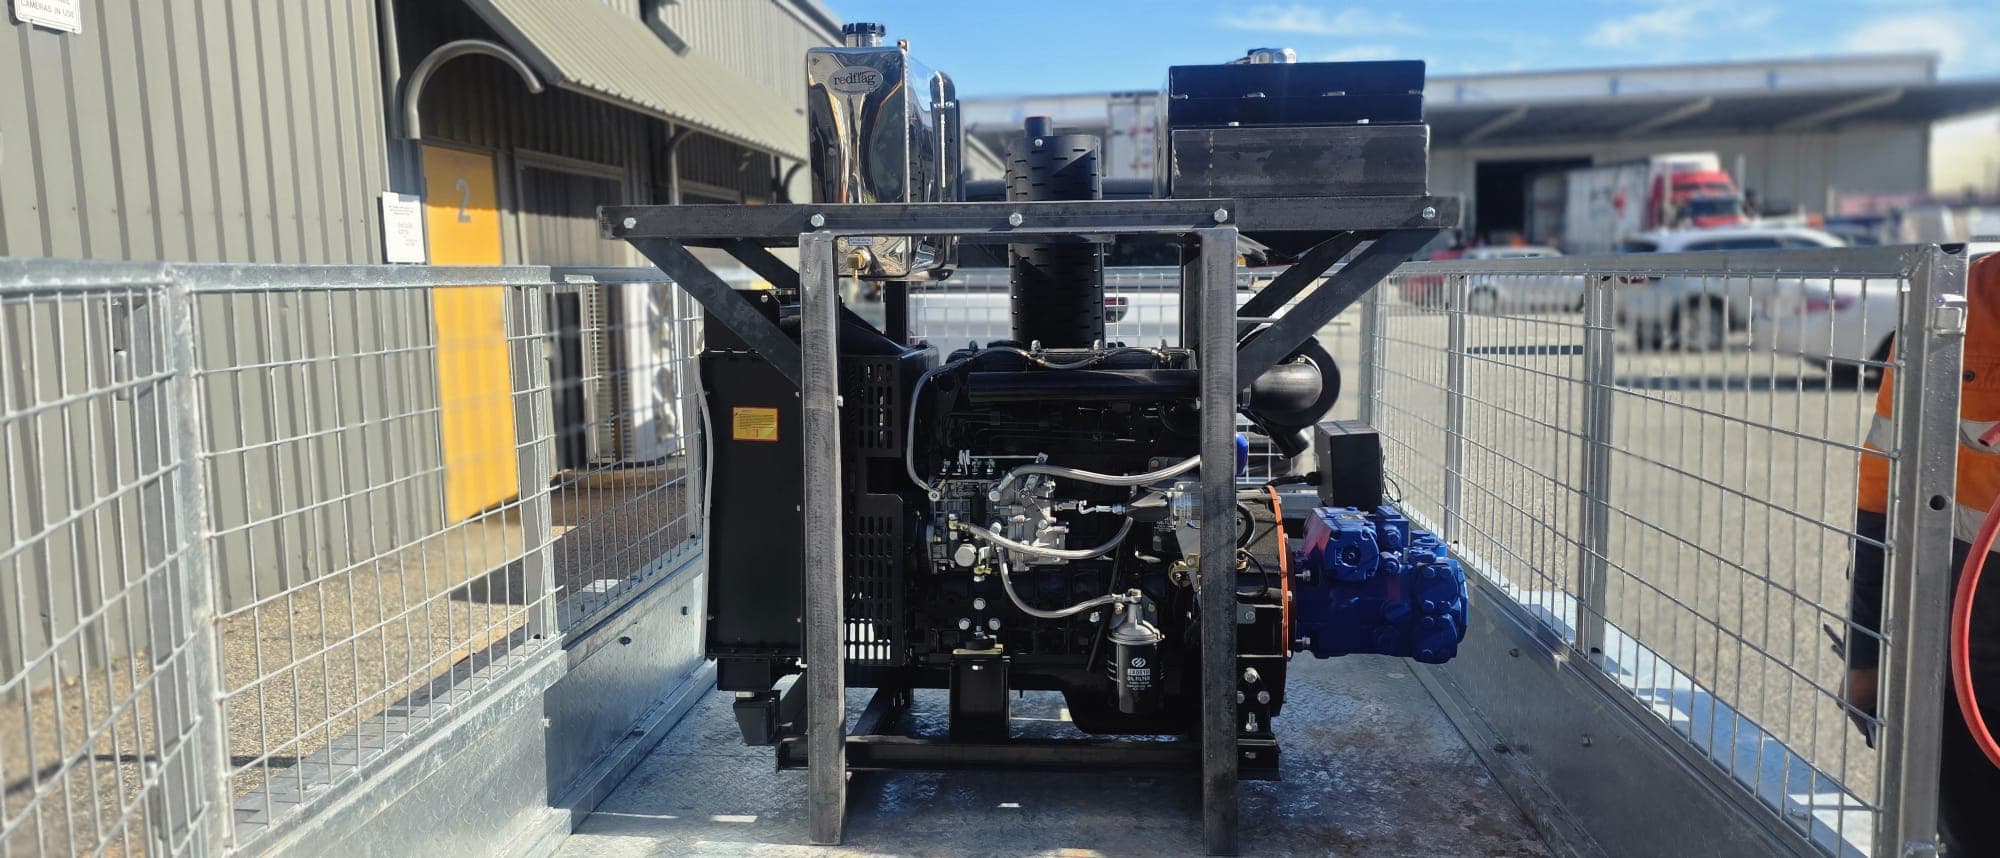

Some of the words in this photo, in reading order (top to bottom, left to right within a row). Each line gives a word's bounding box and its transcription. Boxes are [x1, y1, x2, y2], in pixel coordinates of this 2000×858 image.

[20, 0, 53, 13] CAMERAS
[63, 9, 75, 18] USE
[833, 71, 876, 85] redflag
[455, 179, 471, 223] 2
